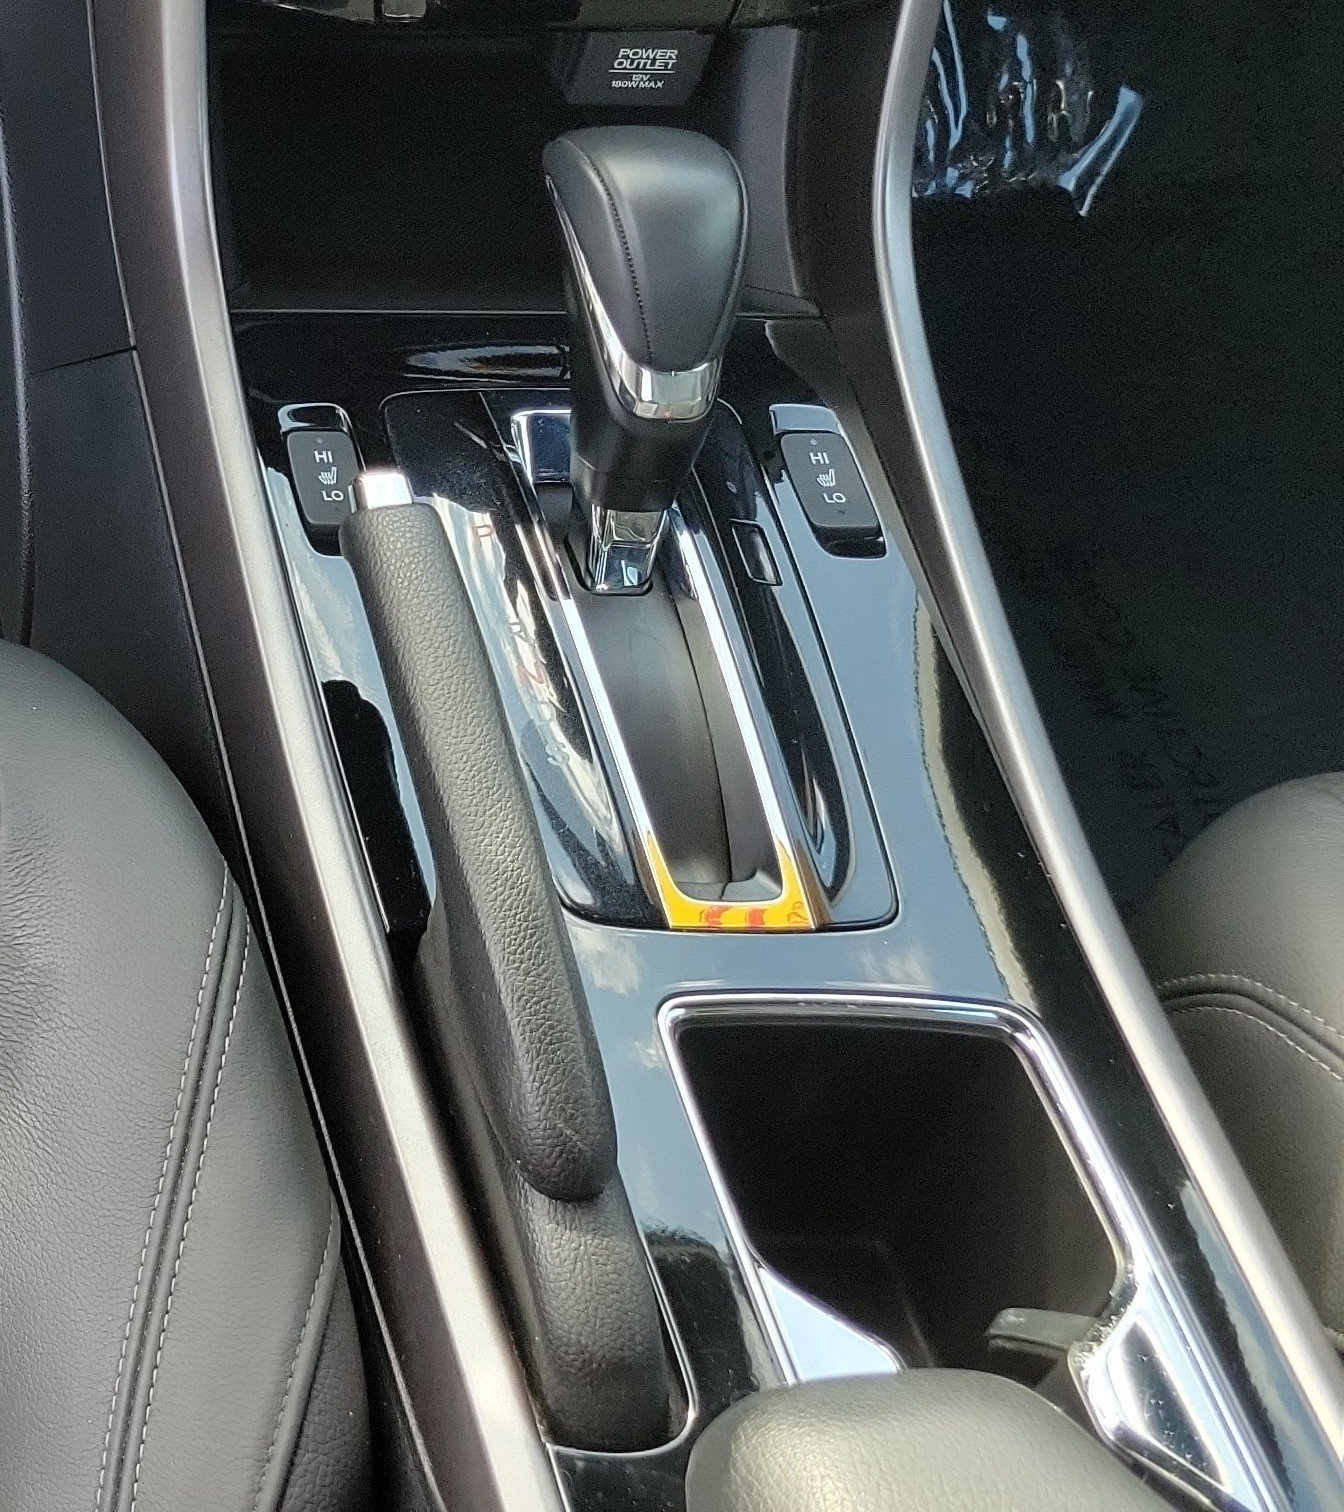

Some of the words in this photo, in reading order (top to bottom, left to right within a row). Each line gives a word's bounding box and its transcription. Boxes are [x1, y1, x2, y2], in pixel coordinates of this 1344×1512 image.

[618, 48, 679, 59] POWER
[613, 59, 678, 69] OUTLET
[313, 450, 333, 463] HI
[809, 451, 830, 465] HI
[321, 489, 344, 501] LO
[822, 492, 847, 503] LO
